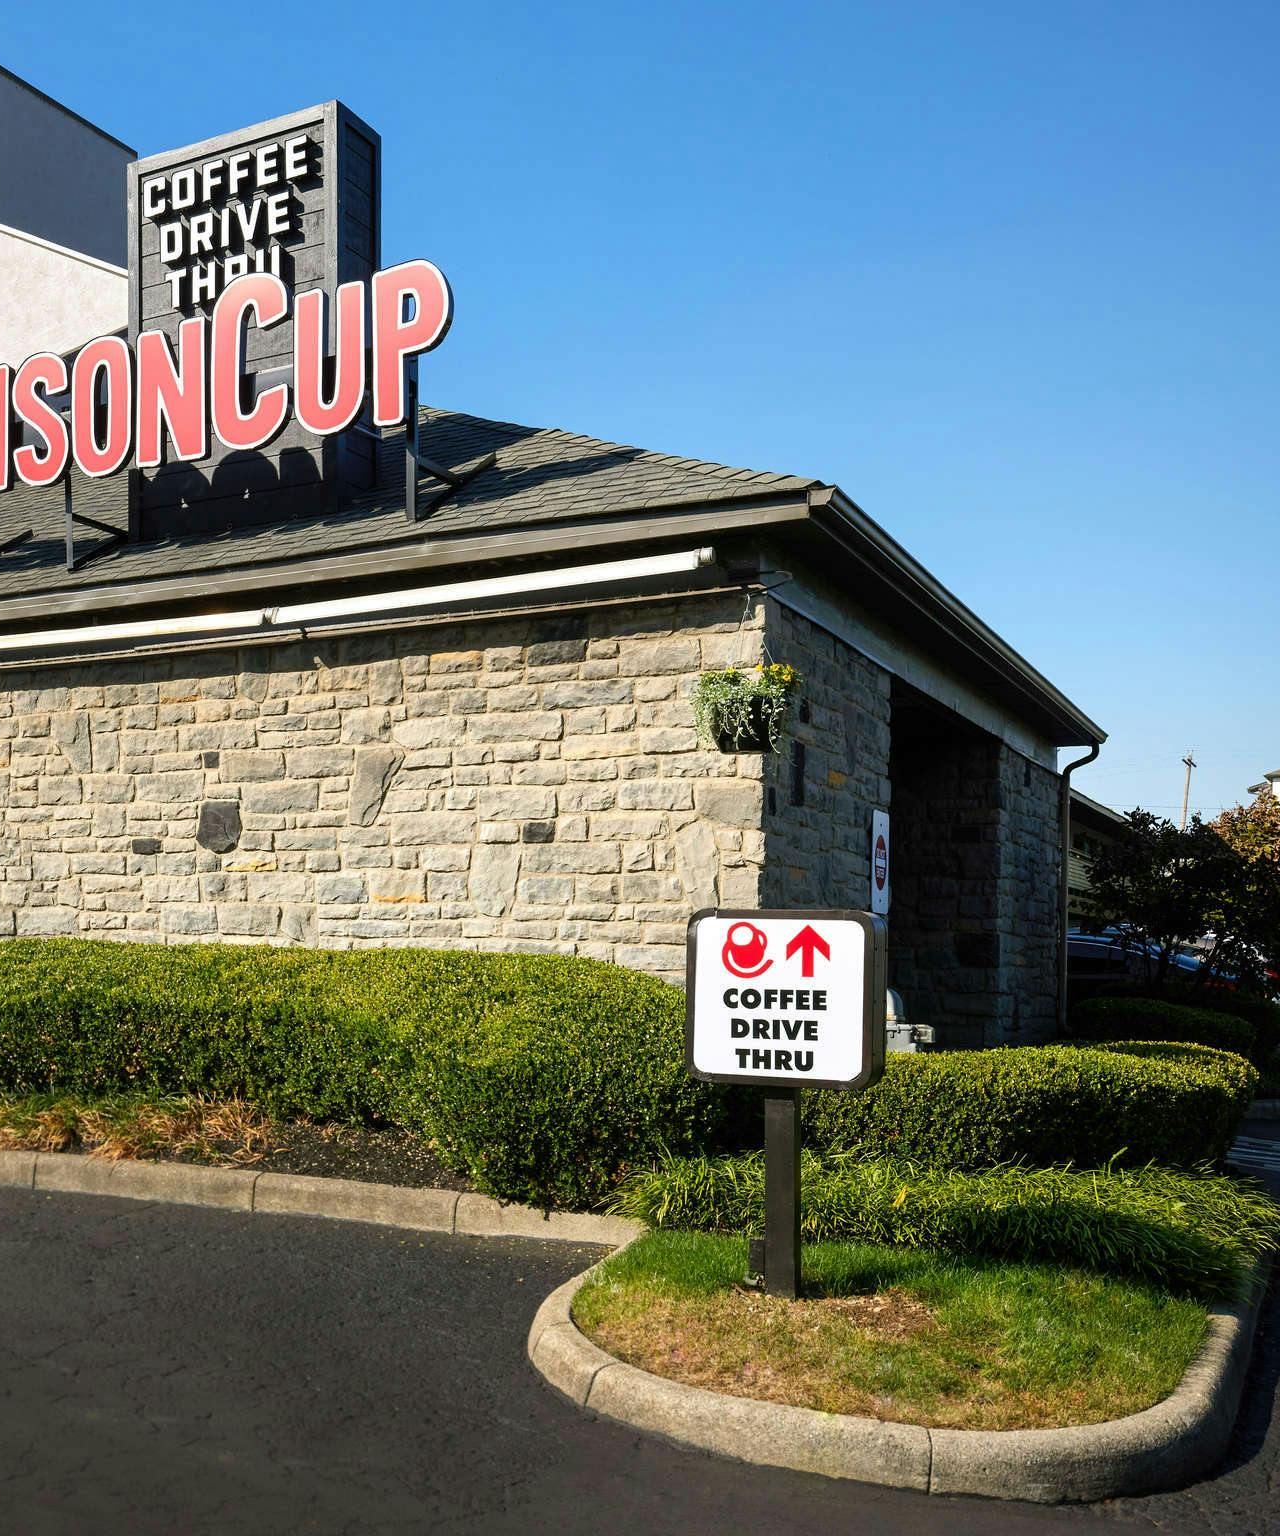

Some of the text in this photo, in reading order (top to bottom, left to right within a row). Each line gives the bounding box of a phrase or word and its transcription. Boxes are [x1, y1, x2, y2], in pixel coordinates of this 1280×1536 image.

[143, 134, 308, 218] COFFEE
[160, 191, 290, 264] DRIVE
[722, 987, 828, 1011] COFFEE
[730, 1018, 819, 1041] DRIVE
[734, 1048, 815, 1072] THRU
